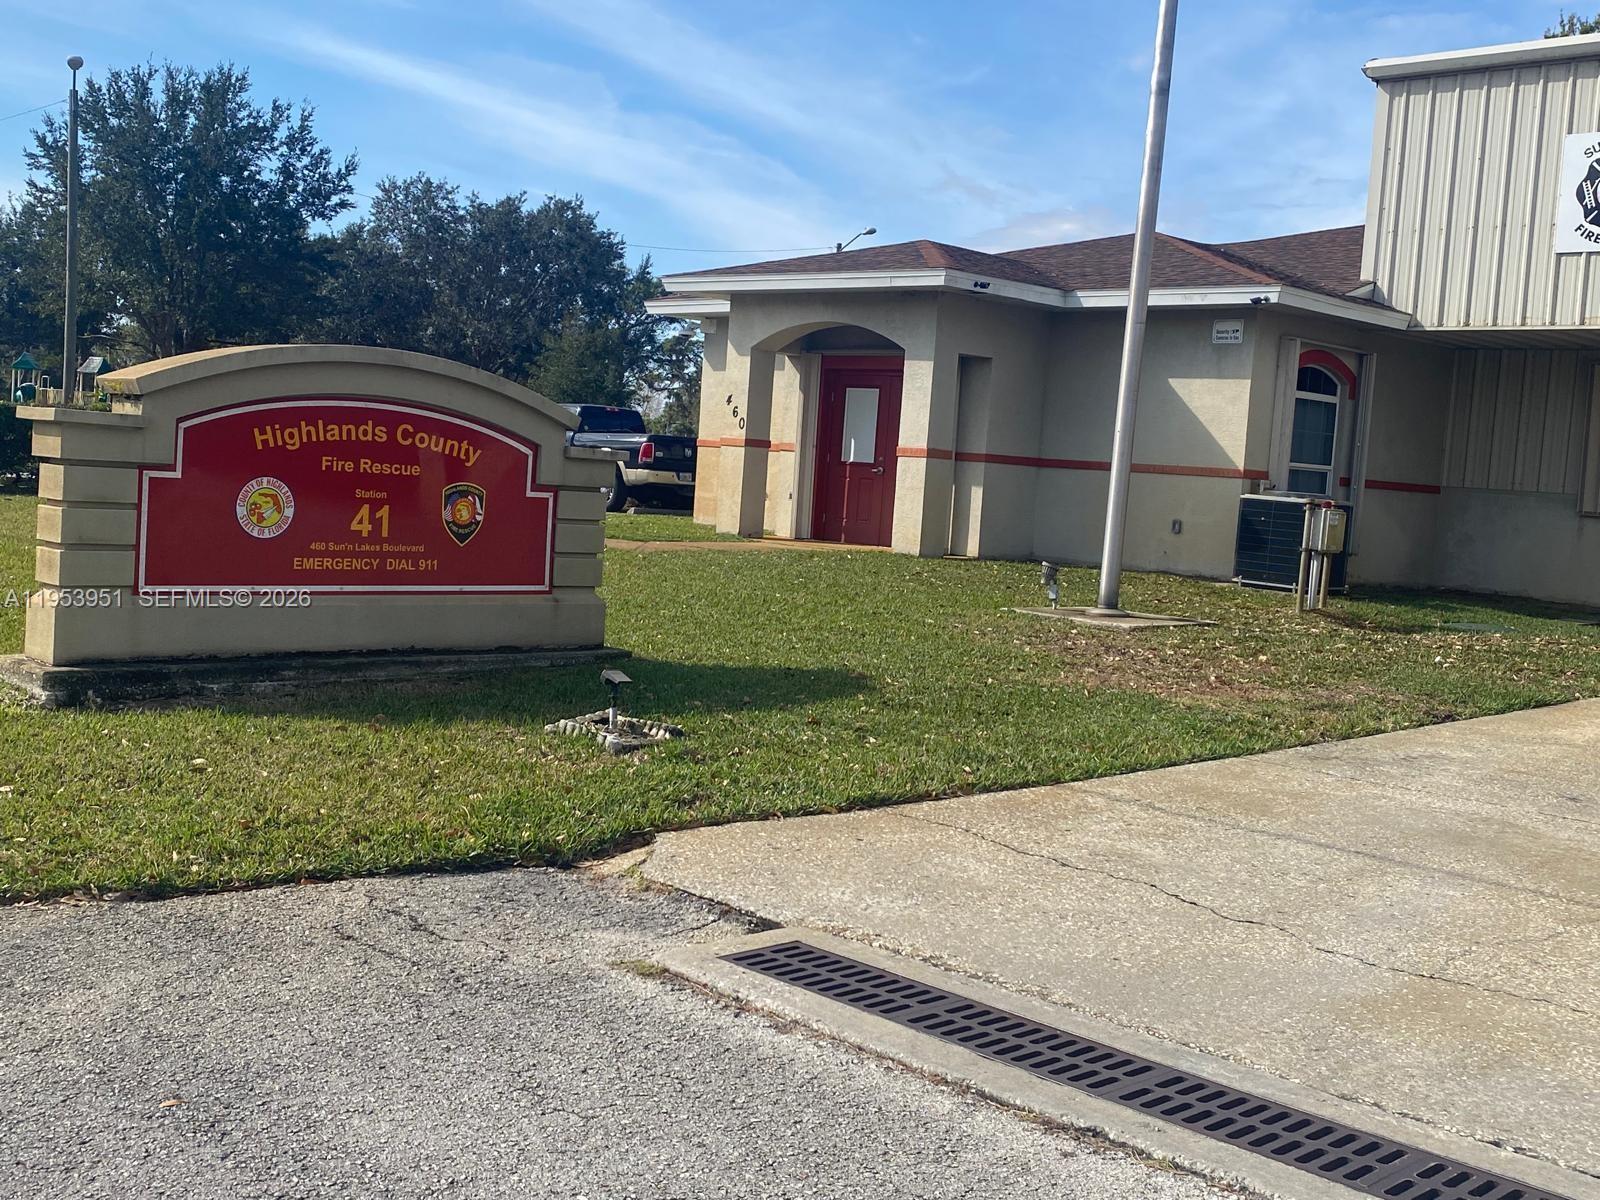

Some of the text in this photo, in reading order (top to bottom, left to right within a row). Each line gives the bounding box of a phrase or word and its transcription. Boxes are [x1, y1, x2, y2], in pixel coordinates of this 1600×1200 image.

[726, 394, 745, 430] 460
[253, 419, 482, 467] Highlands County
[321, 456, 421, 476] Fire Rescue
[238, 478, 293, 509] COUNTY OF HIGHLANDS
[355, 488, 387, 499] Station
[239, 513, 291, 536] STATE OF FLORIDA
[350, 503, 390, 538] 41
[310, 542, 425, 552] 460 Sun'n Lakes Boulevard
[293, 557, 438, 570] EMERGENCY DIAL 911
